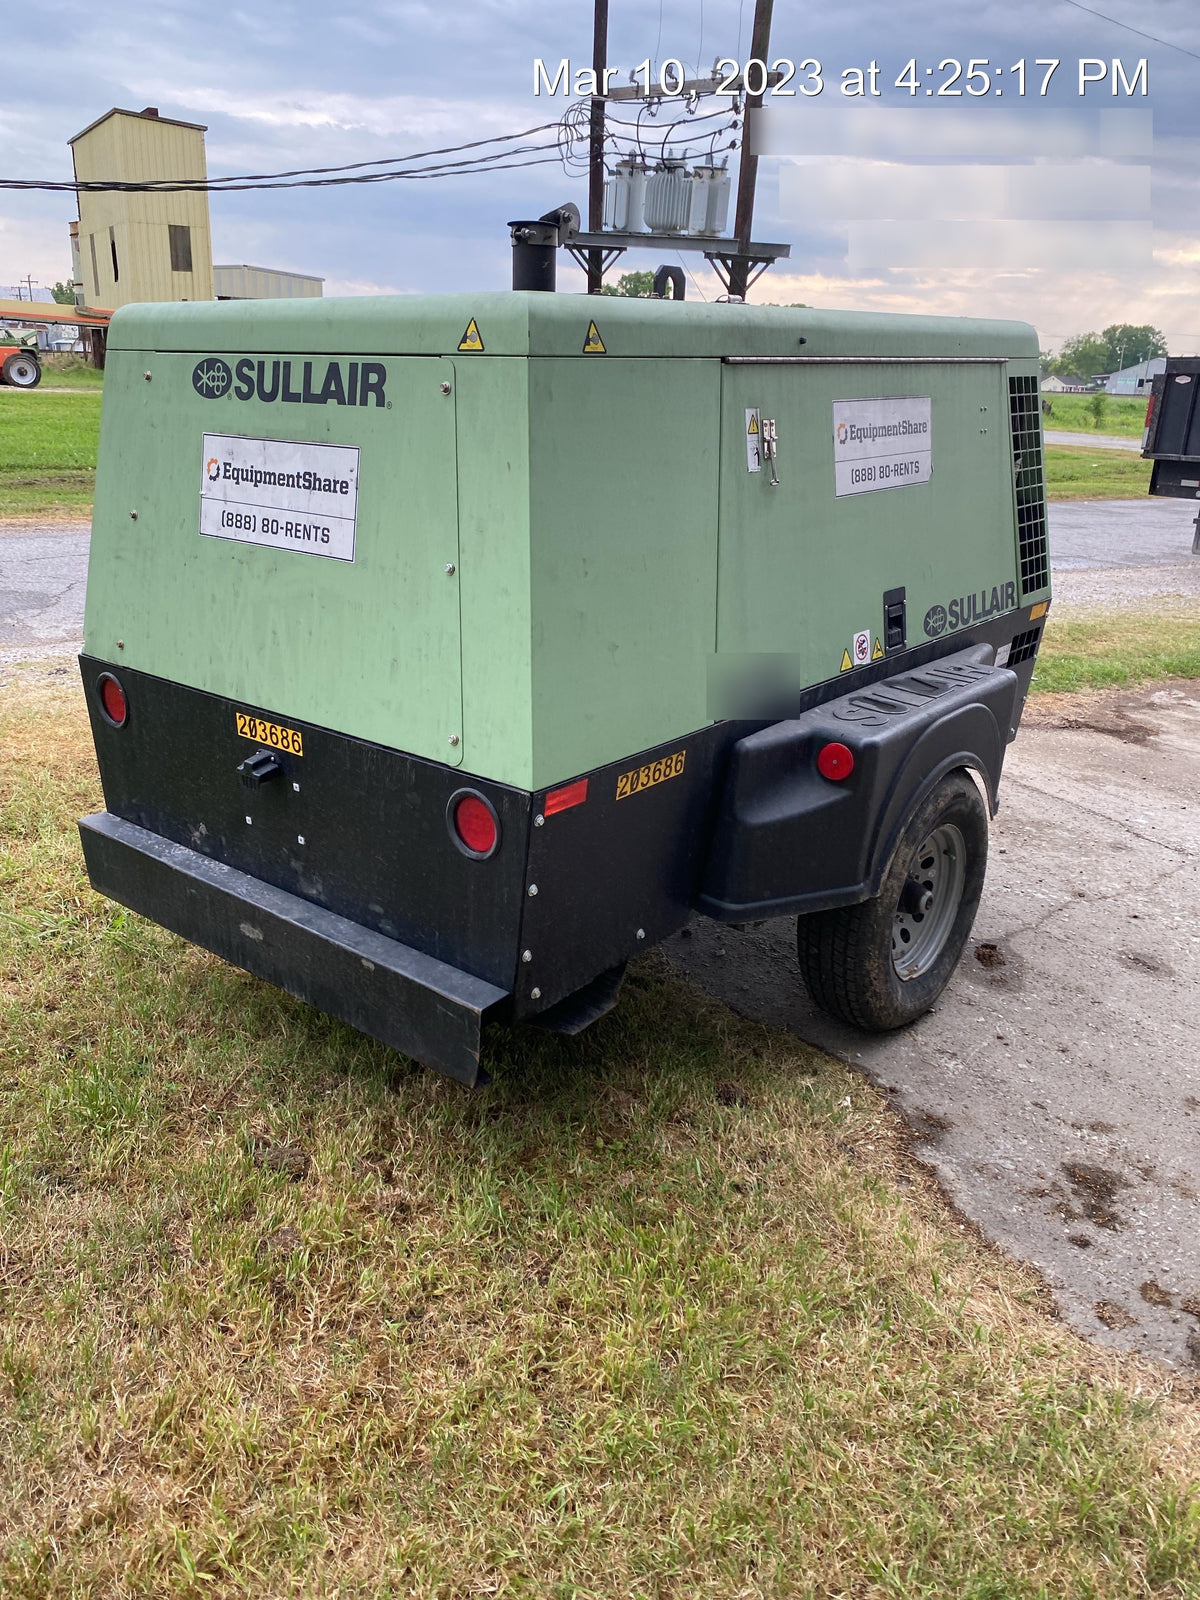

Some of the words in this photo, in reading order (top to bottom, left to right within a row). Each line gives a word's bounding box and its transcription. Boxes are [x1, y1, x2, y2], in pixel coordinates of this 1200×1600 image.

[234, 358, 387, 408] SULLAIR
[849, 420, 928, 444] EquipmentShare
[222, 461, 350, 496] EquipmentShare
[851, 465, 877, 485] (888)
[878, 460, 921, 480] 80-RENTS
[221, 509, 257, 533] (888)
[261, 517, 331, 545] 80-RENTS
[948, 580, 1016, 631] SULLAIR
[238, 714, 302, 754] 203686
[617, 752, 685, 797] 203686
